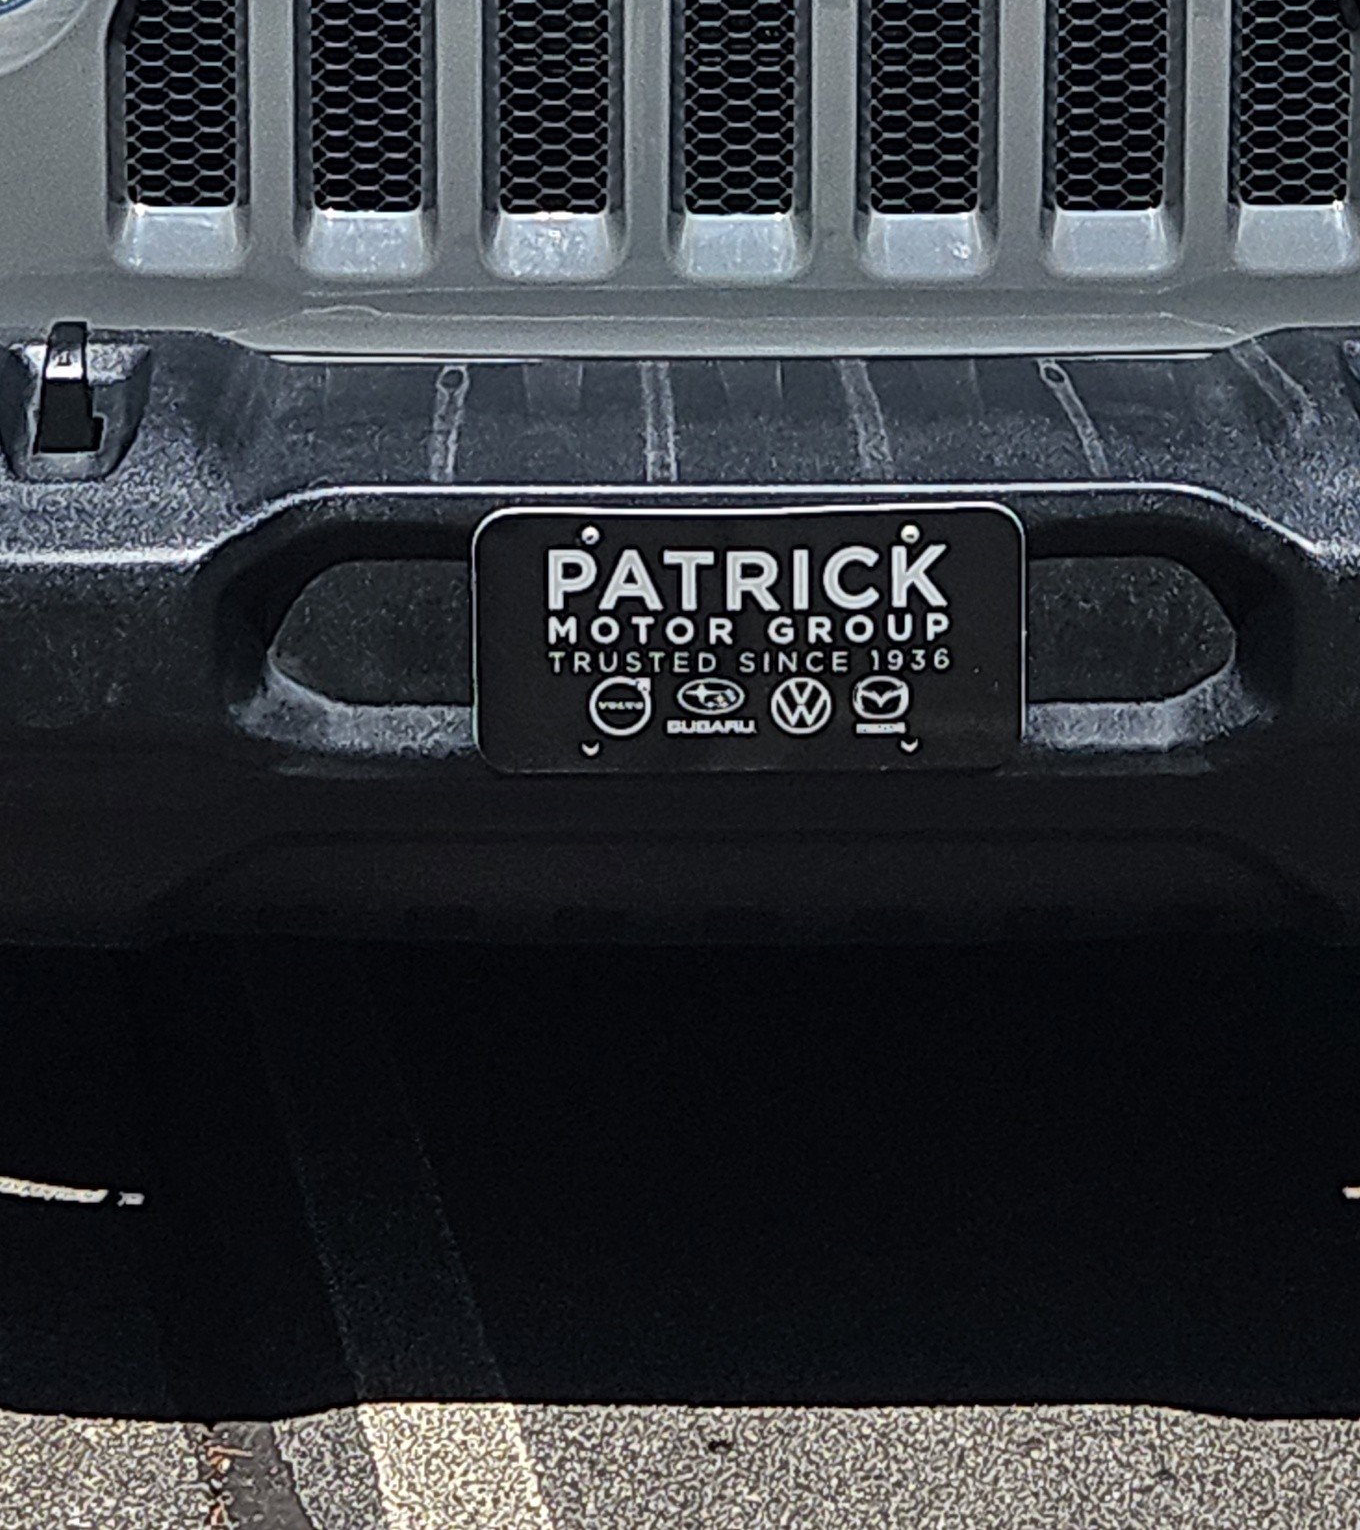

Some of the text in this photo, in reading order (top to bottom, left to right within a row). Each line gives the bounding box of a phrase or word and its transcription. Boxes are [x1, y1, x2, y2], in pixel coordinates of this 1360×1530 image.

[547, 543, 949, 611] PATRICK
[548, 612, 951, 645] MOTOR GROUP
[547, 647, 951, 674] TRUSTED SINCE 1936
[666, 719, 757, 735] SUBARU
